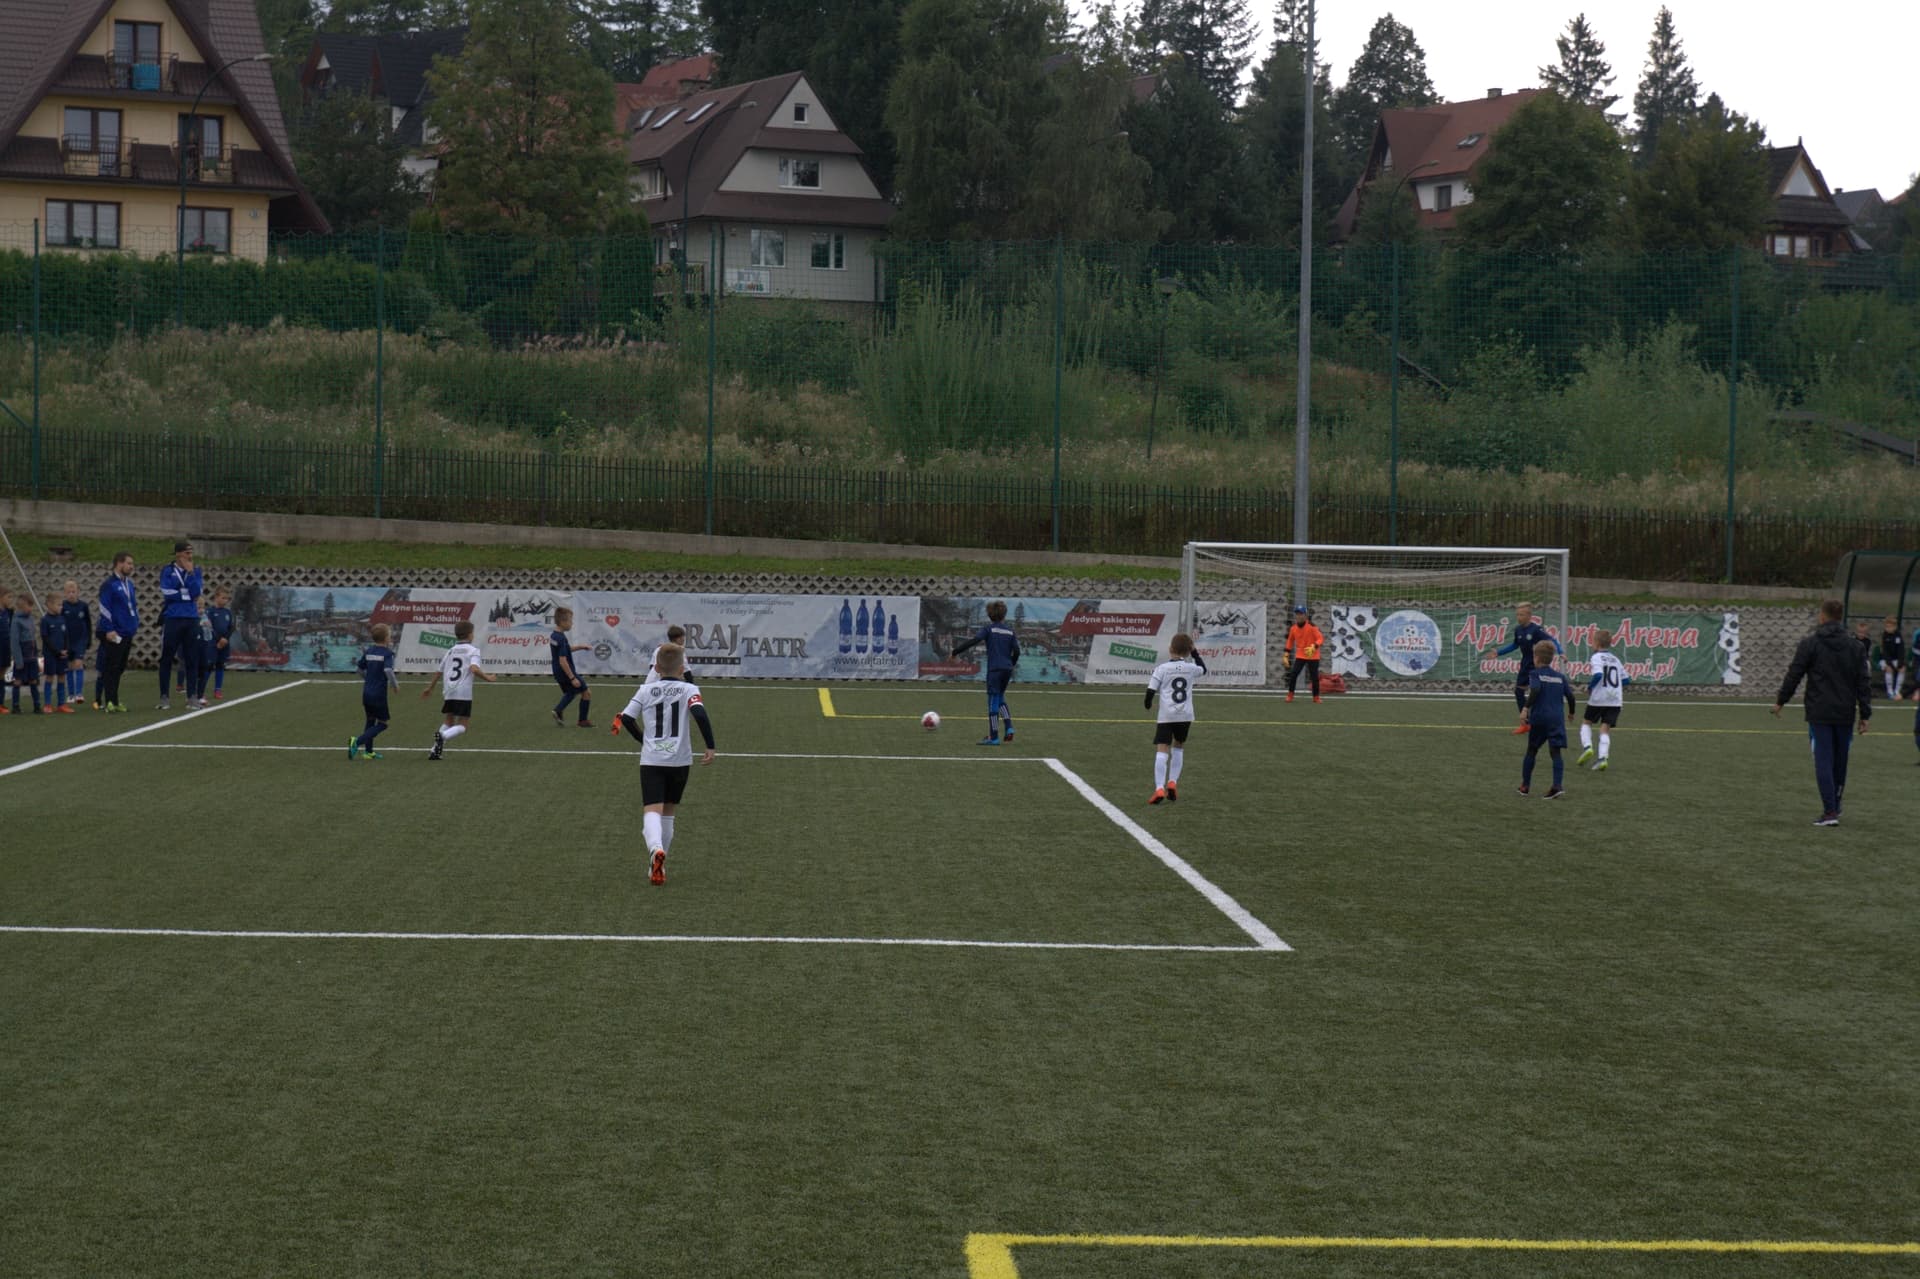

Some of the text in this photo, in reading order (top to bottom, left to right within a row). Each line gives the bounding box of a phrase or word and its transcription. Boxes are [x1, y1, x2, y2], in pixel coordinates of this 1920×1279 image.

[381, 604, 462, 615] Jedyne takie termy
[586, 607, 623, 615] ACTIVE
[425, 614, 461, 623] Podhalu
[1070, 615, 1151, 626] Jedyne takie termy
[1114, 625, 1151, 634] Podhalu
[1455, 614, 1509, 652] Api
[1611, 617, 1699, 649] Arena
[683, 623, 741, 656] RAJ
[742, 636, 809, 658] TATR
[1113, 645, 1155, 660] SZAFLARY
[1221, 645, 1258, 658] Potok
[405, 657, 433, 665] BASENY
[503, 658, 518, 666] SPA
[834, 655, 903, 667] www.rajtatr.eu
[450, 657, 463, 682] 3
[1095, 668, 1122, 676] BASENY
[1211, 669, 1260, 677] RESTAURACJA
[1602, 664, 1619, 688] 10
[1171, 676, 1188, 704] 8
[655, 701, 680, 738] 11
